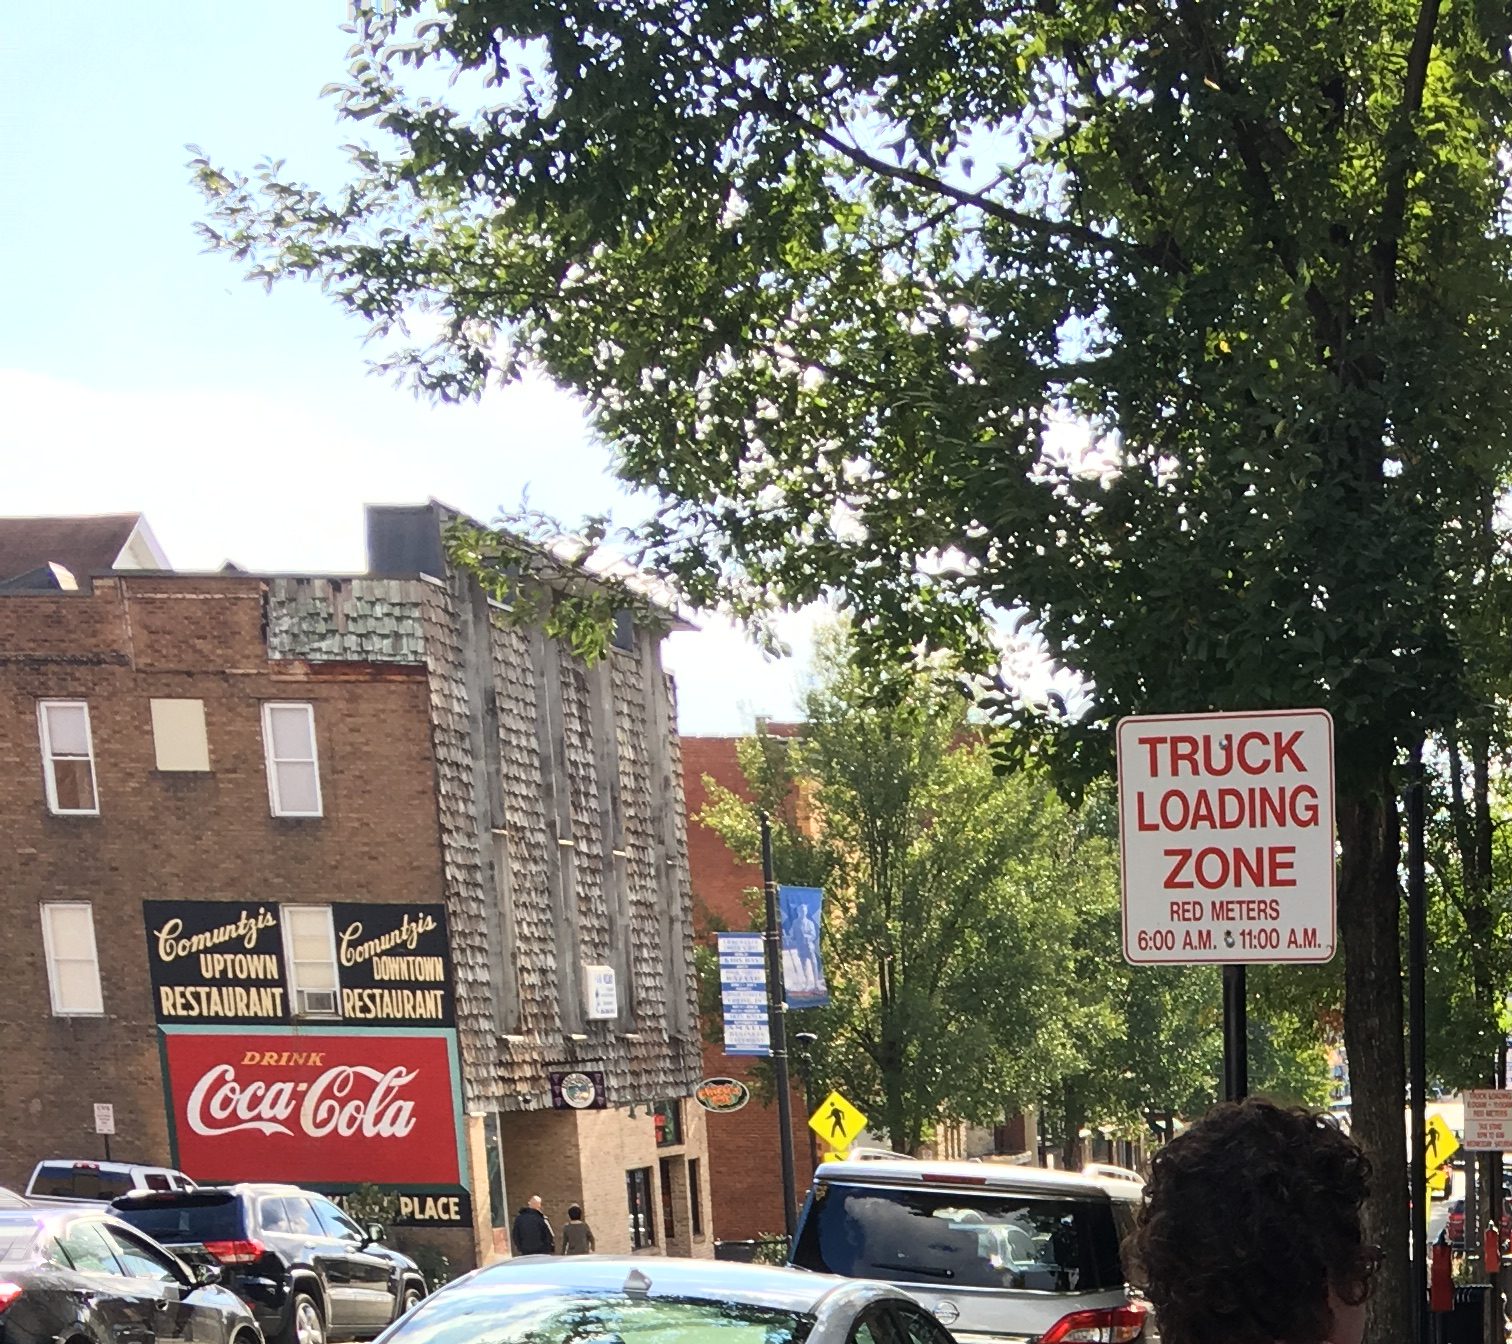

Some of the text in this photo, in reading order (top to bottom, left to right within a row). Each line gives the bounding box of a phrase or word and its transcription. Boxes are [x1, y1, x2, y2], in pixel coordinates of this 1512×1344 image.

[1138, 730, 1308, 778] TRUCK
[1136, 784, 1320, 832] LOADING
[1163, 846, 1297, 889] ZONE
[1170, 899, 1280, 922] RED METERS
[153, 907, 277, 962] Comuntzis
[339, 911, 438, 967] Comuntzis
[1137, 927, 1322, 951] 6:00 A.M. 11:00 A.M.
[199, 953, 279, 980] UPTOWN
[372, 955, 444, 982] DOWNTOWN
[159, 986, 284, 1017] RESTAURANT
[342, 988, 445, 1019] RESTAURANT
[241, 1051, 327, 1066] DRINK
[187, 1063, 420, 1138] Coca-Cola
[400, 1196, 461, 1220] PLACE
